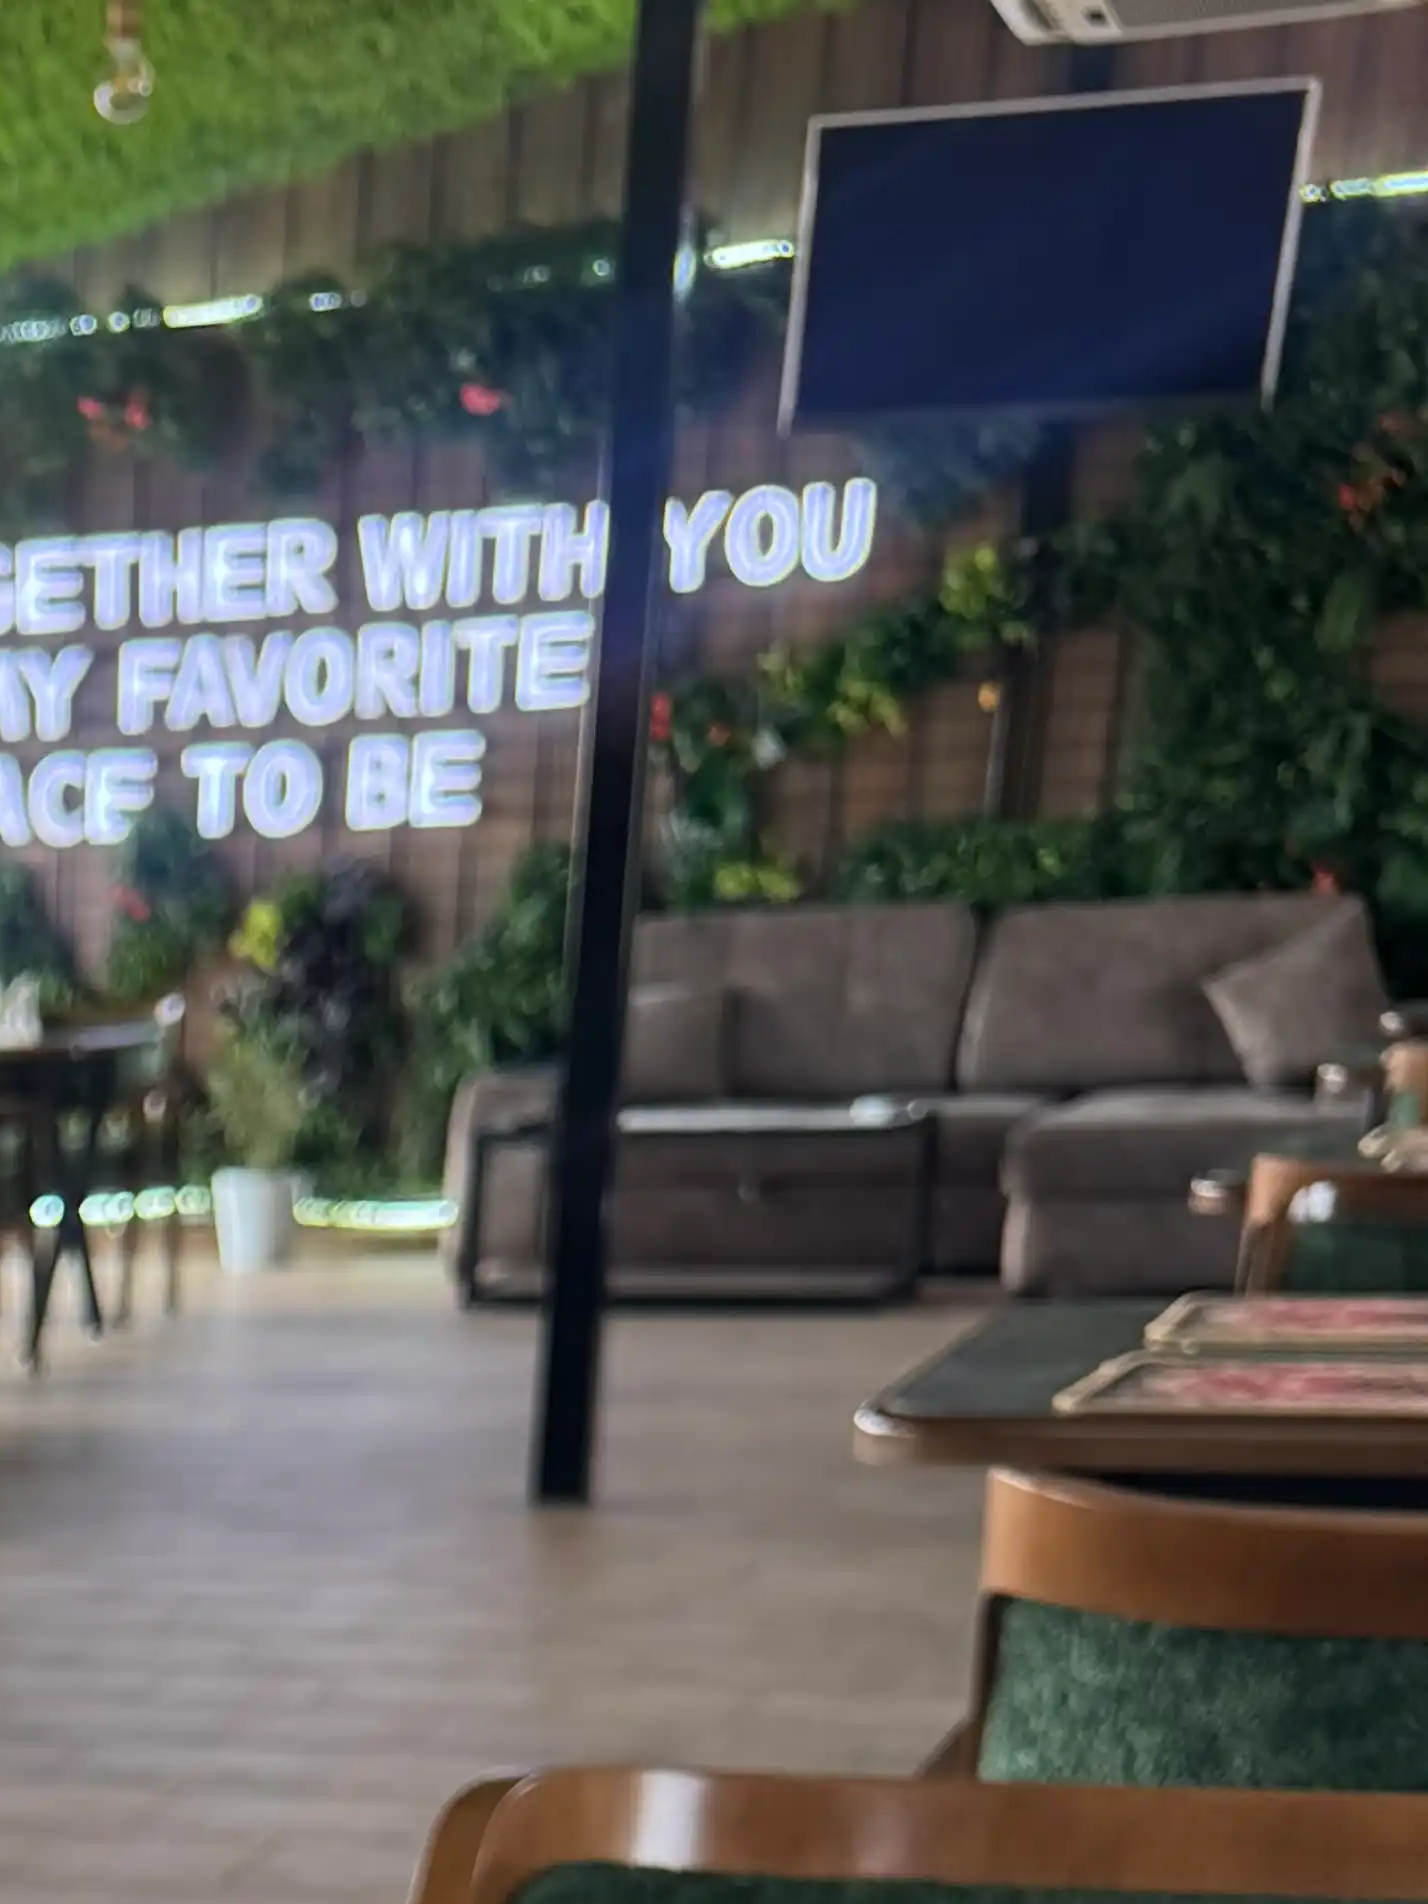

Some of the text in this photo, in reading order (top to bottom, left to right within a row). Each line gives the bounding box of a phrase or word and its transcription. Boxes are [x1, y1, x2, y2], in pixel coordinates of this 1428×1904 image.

[358, 499, 609, 612] WITH
[663, 477, 877, 594] YOU
[116, 610, 596, 736] FAVORITE
[181, 737, 324, 840] TO
[345, 729, 486, 832] BE
